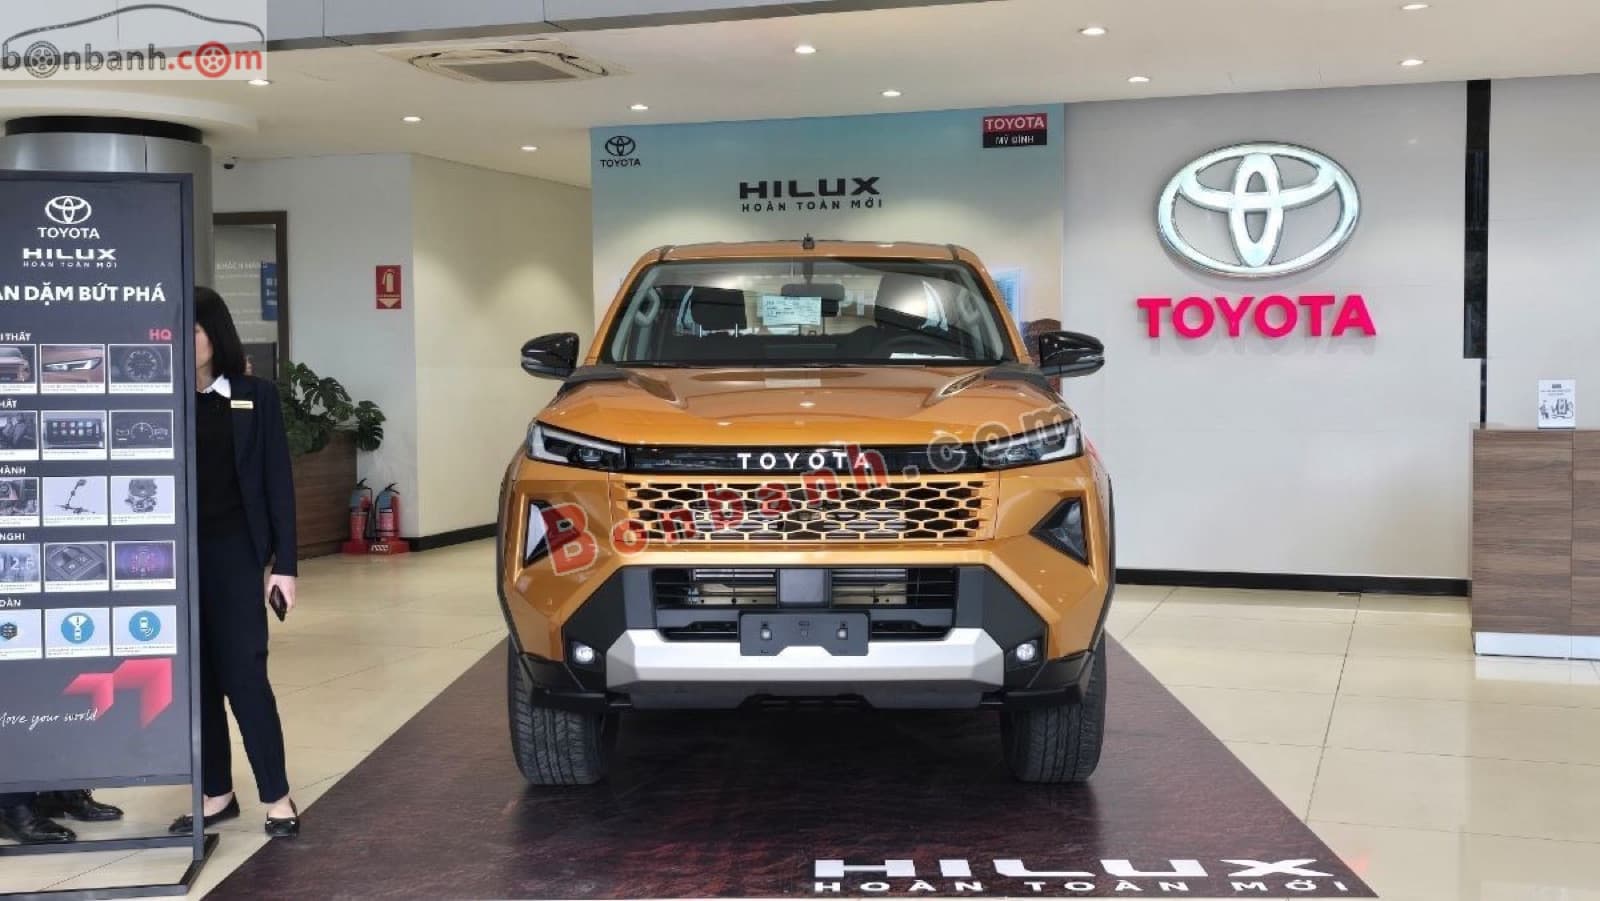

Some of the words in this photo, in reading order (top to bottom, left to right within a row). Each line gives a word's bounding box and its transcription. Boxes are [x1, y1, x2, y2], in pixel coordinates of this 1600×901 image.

[985, 116, 1045, 129] TOYOTA
[600, 158, 641, 168] TOYOTA
[739, 177, 881, 199] HILUX
[742, 201, 786, 212] HOÀN
[797, 199, 840, 210] TOÀN
[851, 197, 882, 209] MỚI
[38, 227, 100, 239] TOYOTA
[23, 248, 117, 260] HILUX
[0, 285, 19, 301] N
[25, 282, 74, 306] DẶM
[79, 282, 118, 301] BỨT
[124, 282, 166, 302] PHÁ
[1137, 295, 1377, 338] TOYOTA
[149, 328, 172, 341] HQ
[737, 451, 870, 470] TOYOTA
[815, 859, 1334, 877] HILUX
[815, 880, 983, 892] HOÀN
[1024, 880, 1189, 892] TOÀN
[1231, 879, 1349, 892] MỚI
